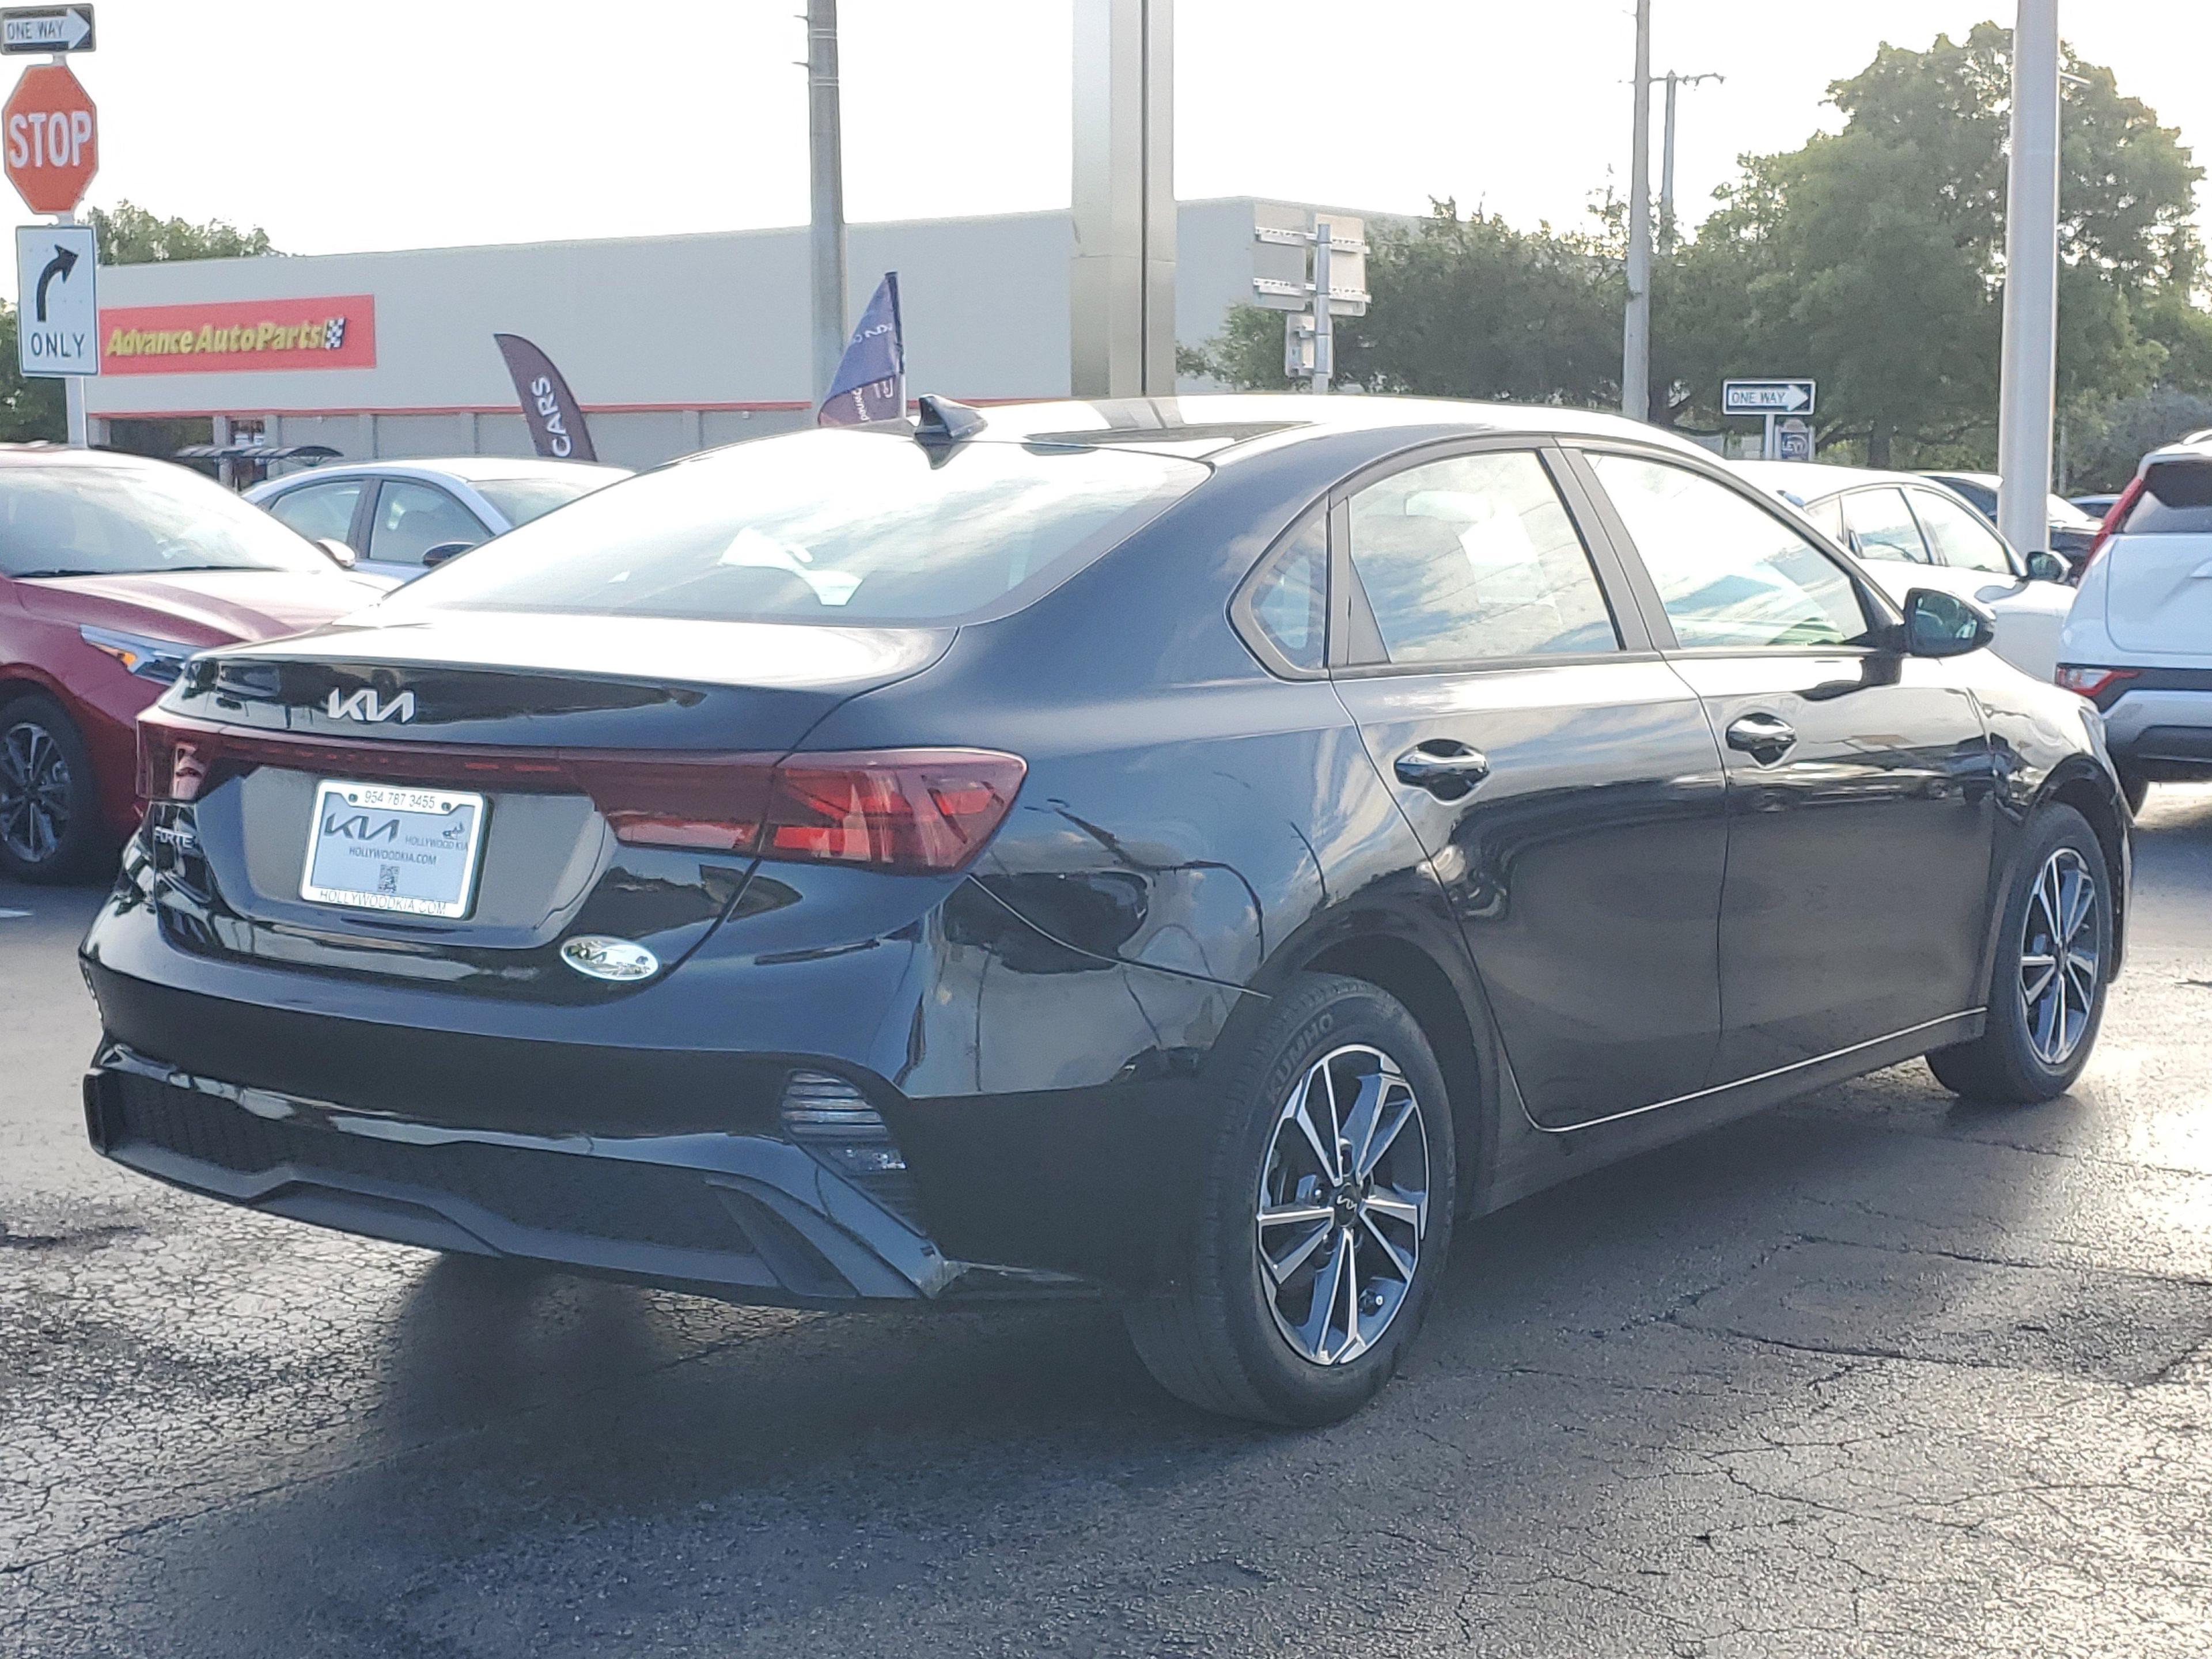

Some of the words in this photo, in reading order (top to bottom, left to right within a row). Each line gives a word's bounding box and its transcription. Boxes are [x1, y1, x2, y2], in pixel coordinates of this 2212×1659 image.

[7, 22, 32, 40] ONE
[37, 20, 65, 38] WAY
[9, 111, 92, 168] STOP
[31, 332, 85, 358] ONLY
[105, 328, 194, 357] Advance
[1732, 392, 1757, 404] ONE
[1760, 392, 1785, 404] WAY
[532, 377, 572, 457] CARS
[328, 687, 415, 724] KIA
[365, 790, 384, 803] 954
[388, 792, 407, 806] 787
[409, 796, 436, 809] 3455
[324, 813, 400, 843] KIA
[349, 846, 437, 866] HOLLYWOODKIA.COM
[320, 889, 447, 915] HOLLYWOODKIACOM
